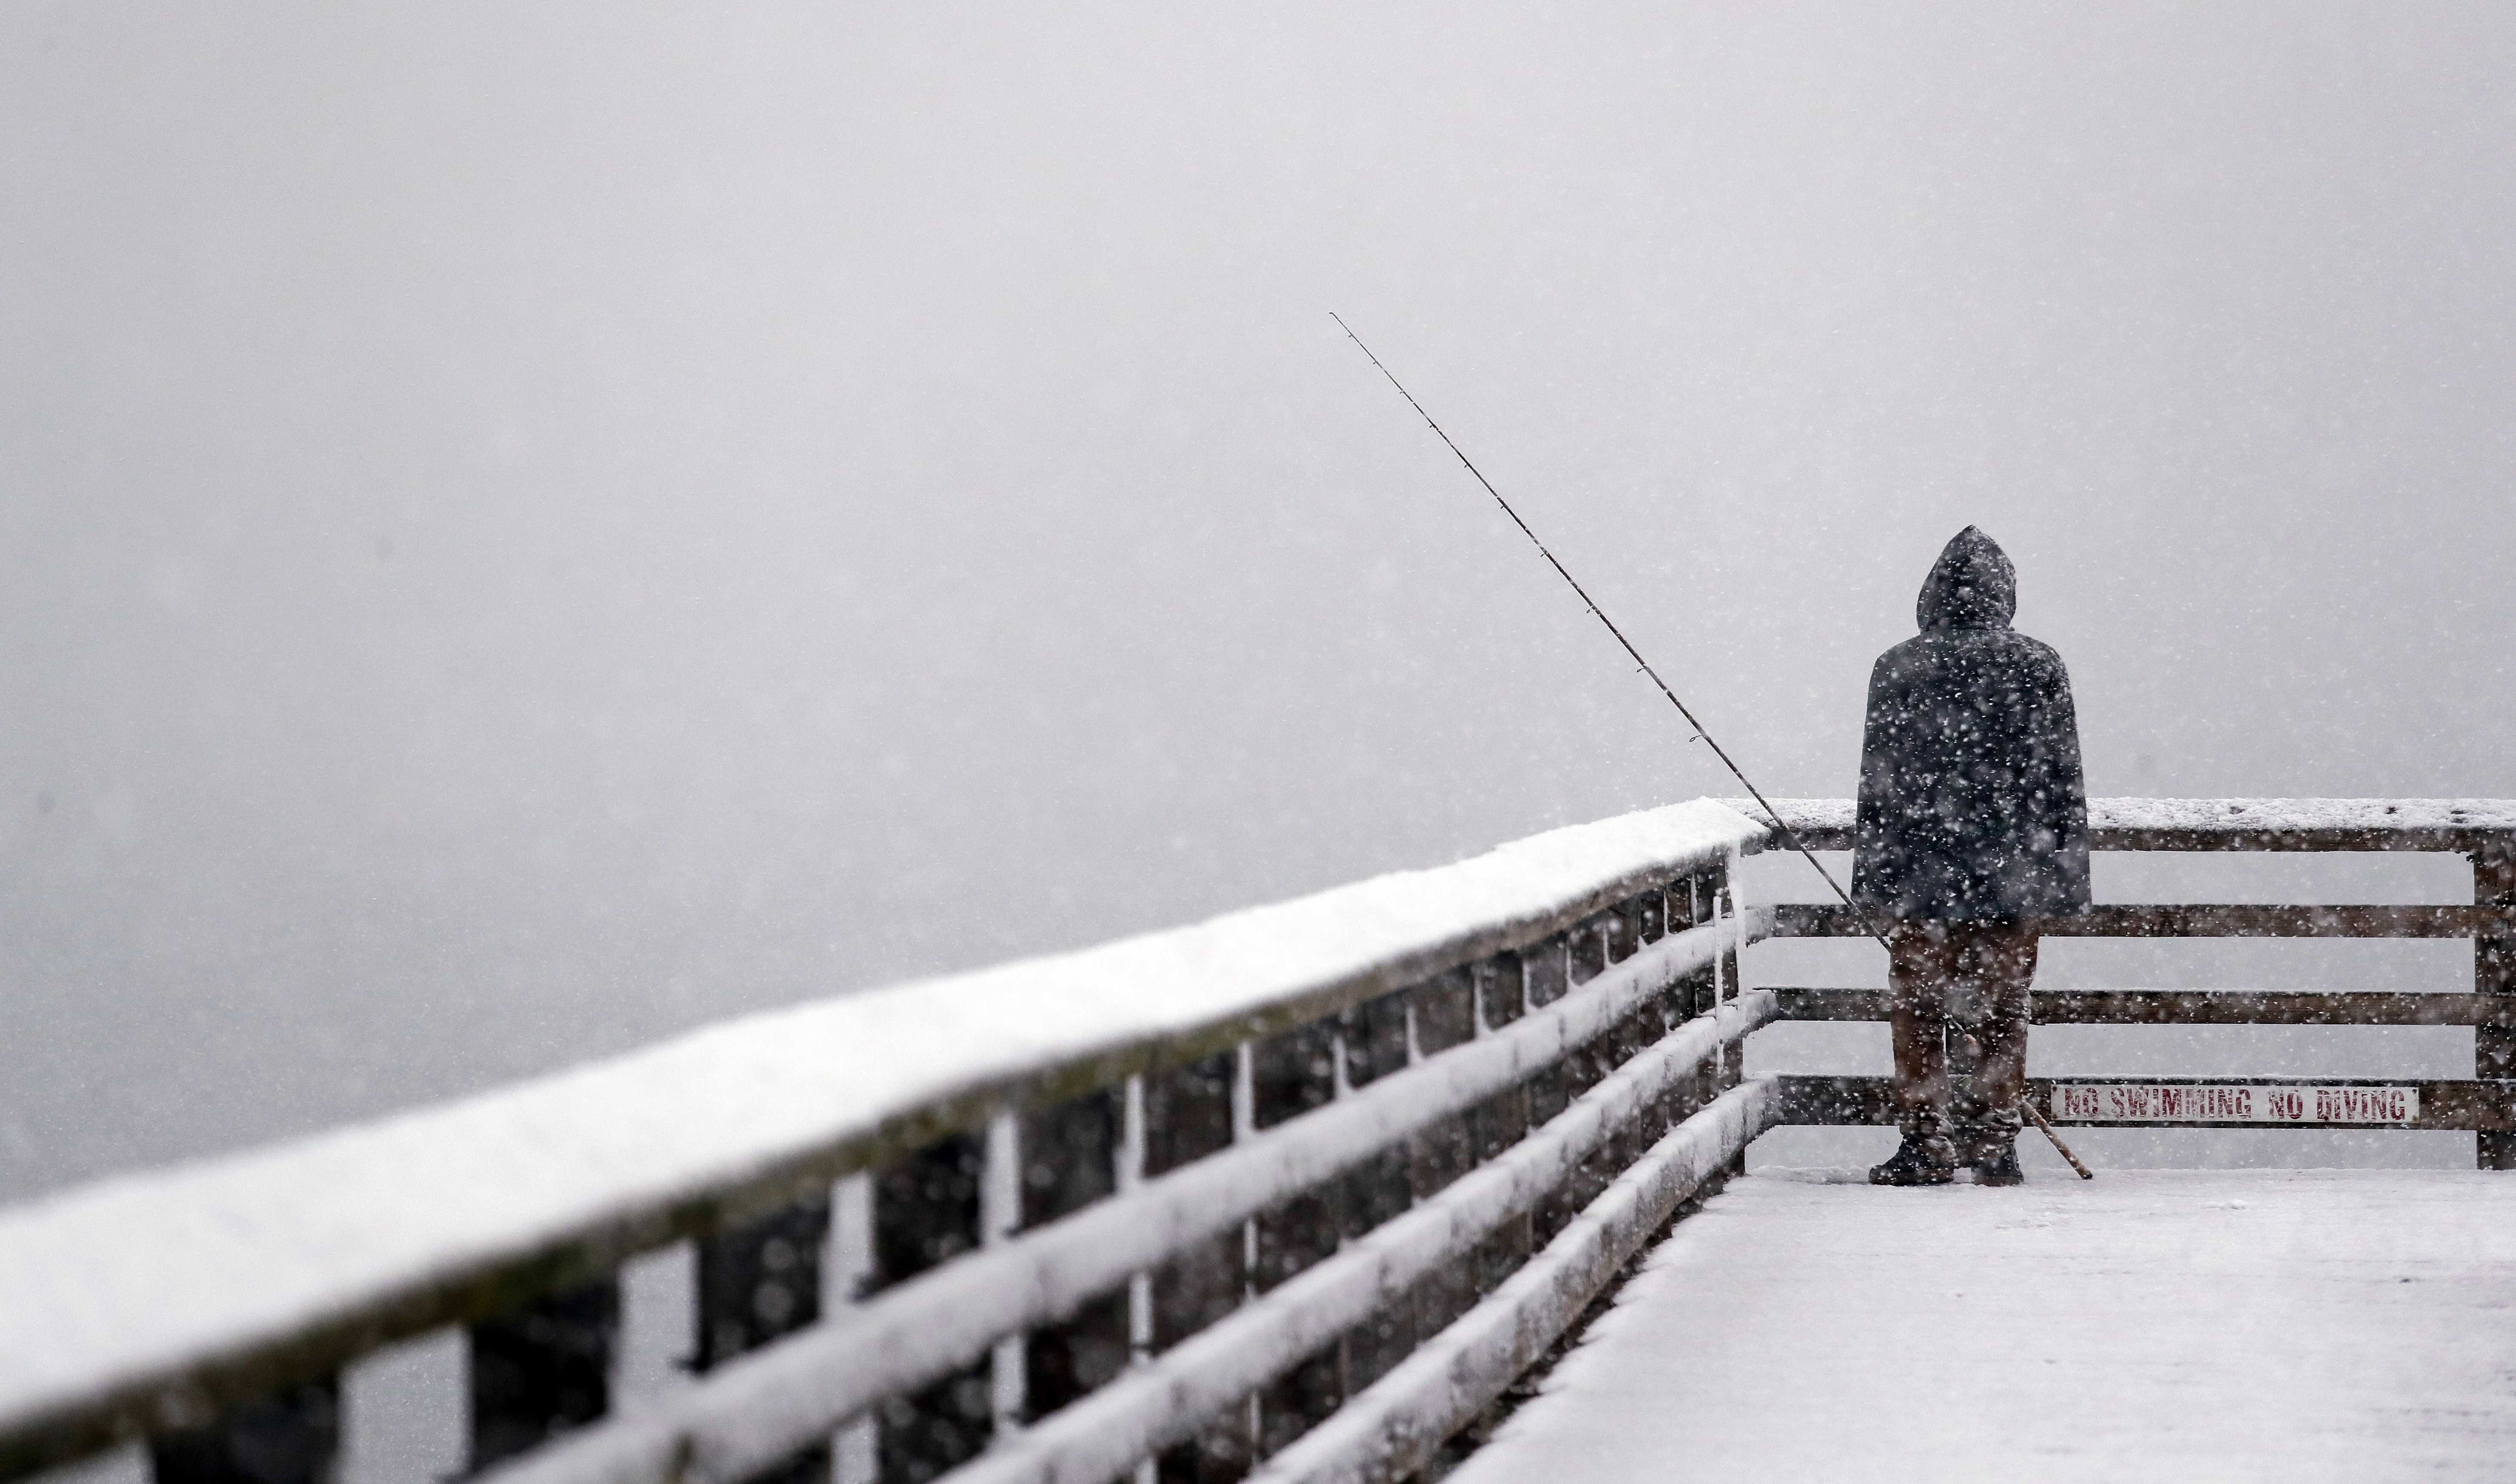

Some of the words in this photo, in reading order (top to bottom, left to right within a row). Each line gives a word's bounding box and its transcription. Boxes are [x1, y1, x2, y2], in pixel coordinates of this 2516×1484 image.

[2065, 1087, 2098, 1117] NO
[2110, 1088, 2251, 1118] SWIMMING
[2268, 1090, 2303, 1119] NO
[2317, 1090, 2405, 1120] DIVING
